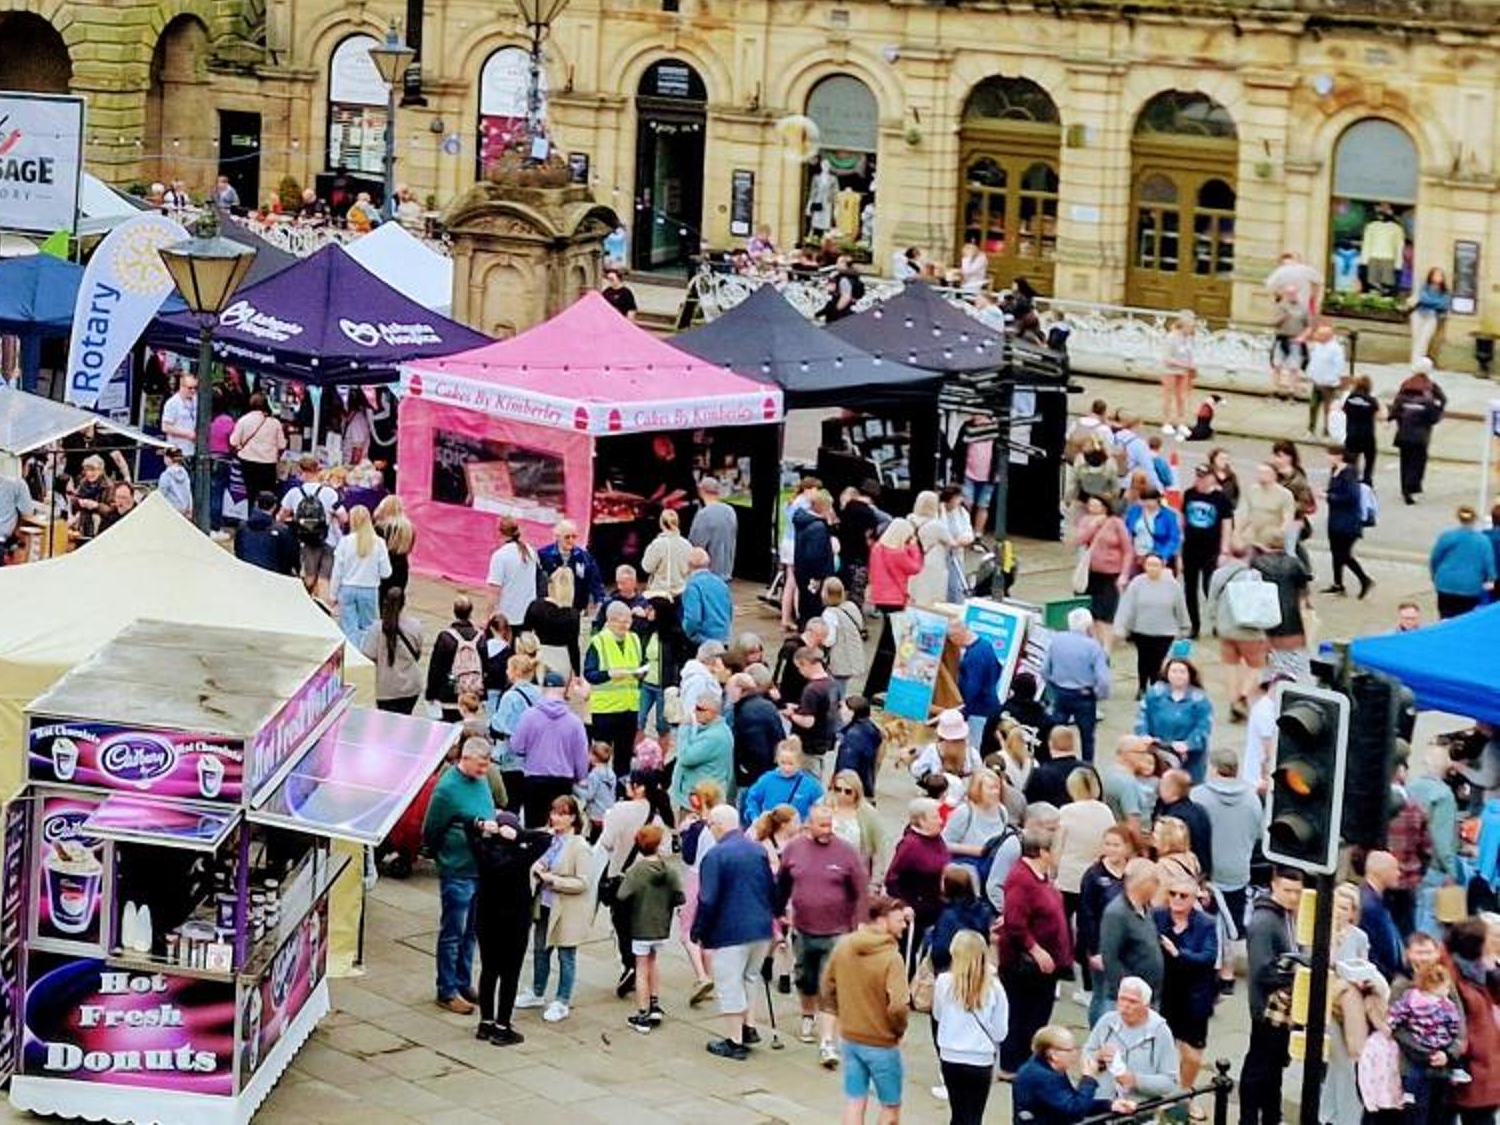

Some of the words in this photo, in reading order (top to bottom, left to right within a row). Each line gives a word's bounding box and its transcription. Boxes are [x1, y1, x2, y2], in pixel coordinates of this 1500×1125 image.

[73, 282, 121, 393] Rotary
[435, 382, 470, 403] Cakes
[475, 390, 490, 409] By
[495, 394, 562, 424] Kimberley
[635, 409, 668, 427] Cakes
[675, 408, 688, 428] By
[105, 744, 165, 773] Cadbury
[98, 971, 169, 995] Hot
[78, 1004, 184, 1027] Fresh
[43, 1042, 217, 1072] Donuts
